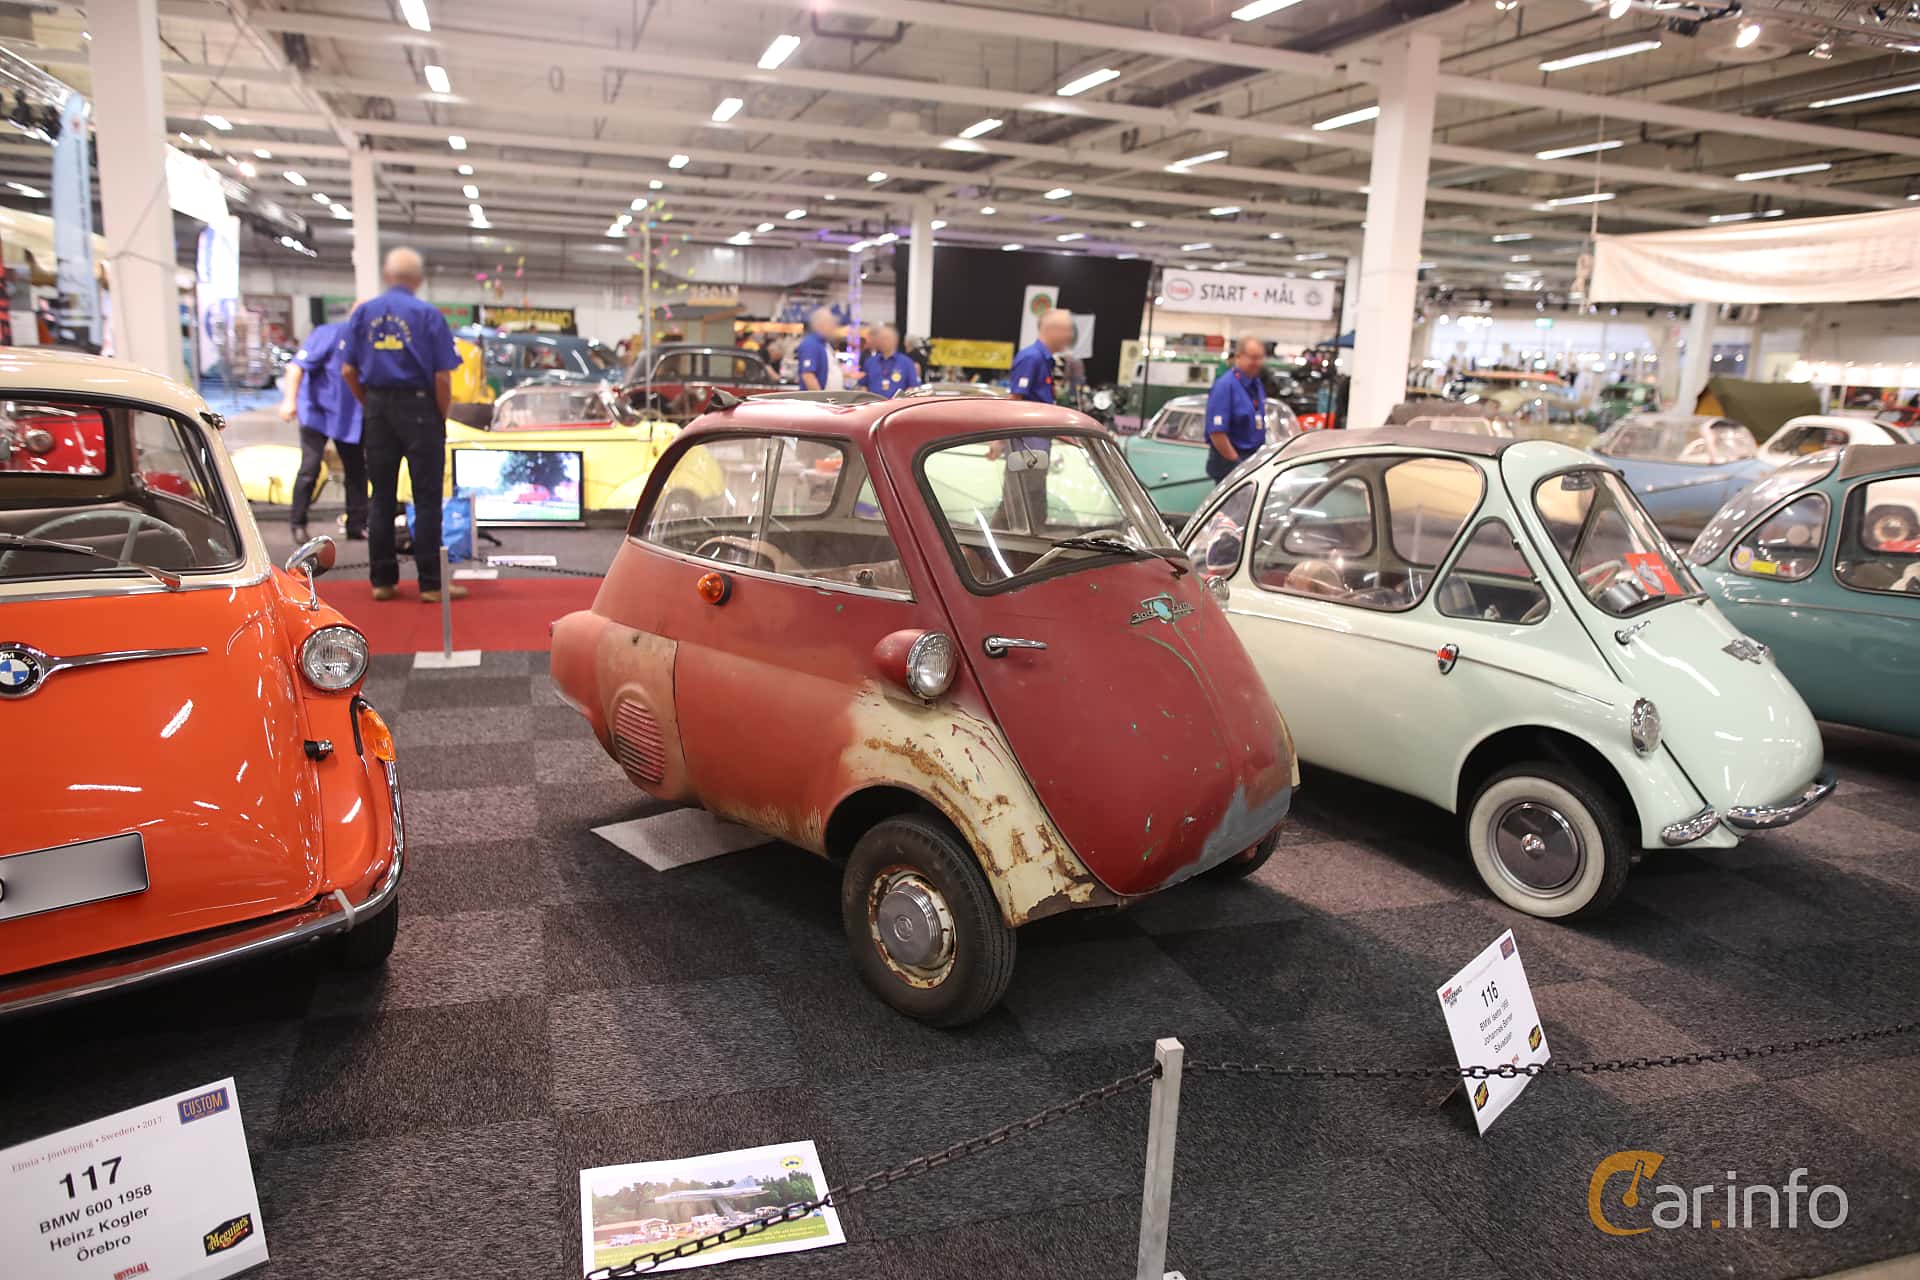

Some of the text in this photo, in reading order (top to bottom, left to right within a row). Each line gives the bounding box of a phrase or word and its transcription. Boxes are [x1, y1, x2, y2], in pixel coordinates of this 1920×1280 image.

[1200, 283, 1246, 301] START
[1264, 282, 1296, 306] MÅL
[1481, 980, 1499, 1008] 116
[182, 1091, 224, 1118] CUSTOM
[47, 1140, 95, 1161] Jönköping
[101, 1126, 136, 1144] Sweden
[143, 1116, 163, 1130] 2017
[59, 1156, 122, 1199] 117
[39, 1184, 153, 1235] BMW 600 1958
[50, 1206, 150, 1252] Heinz Kogler
[76, 1234, 132, 1262] Örebro
